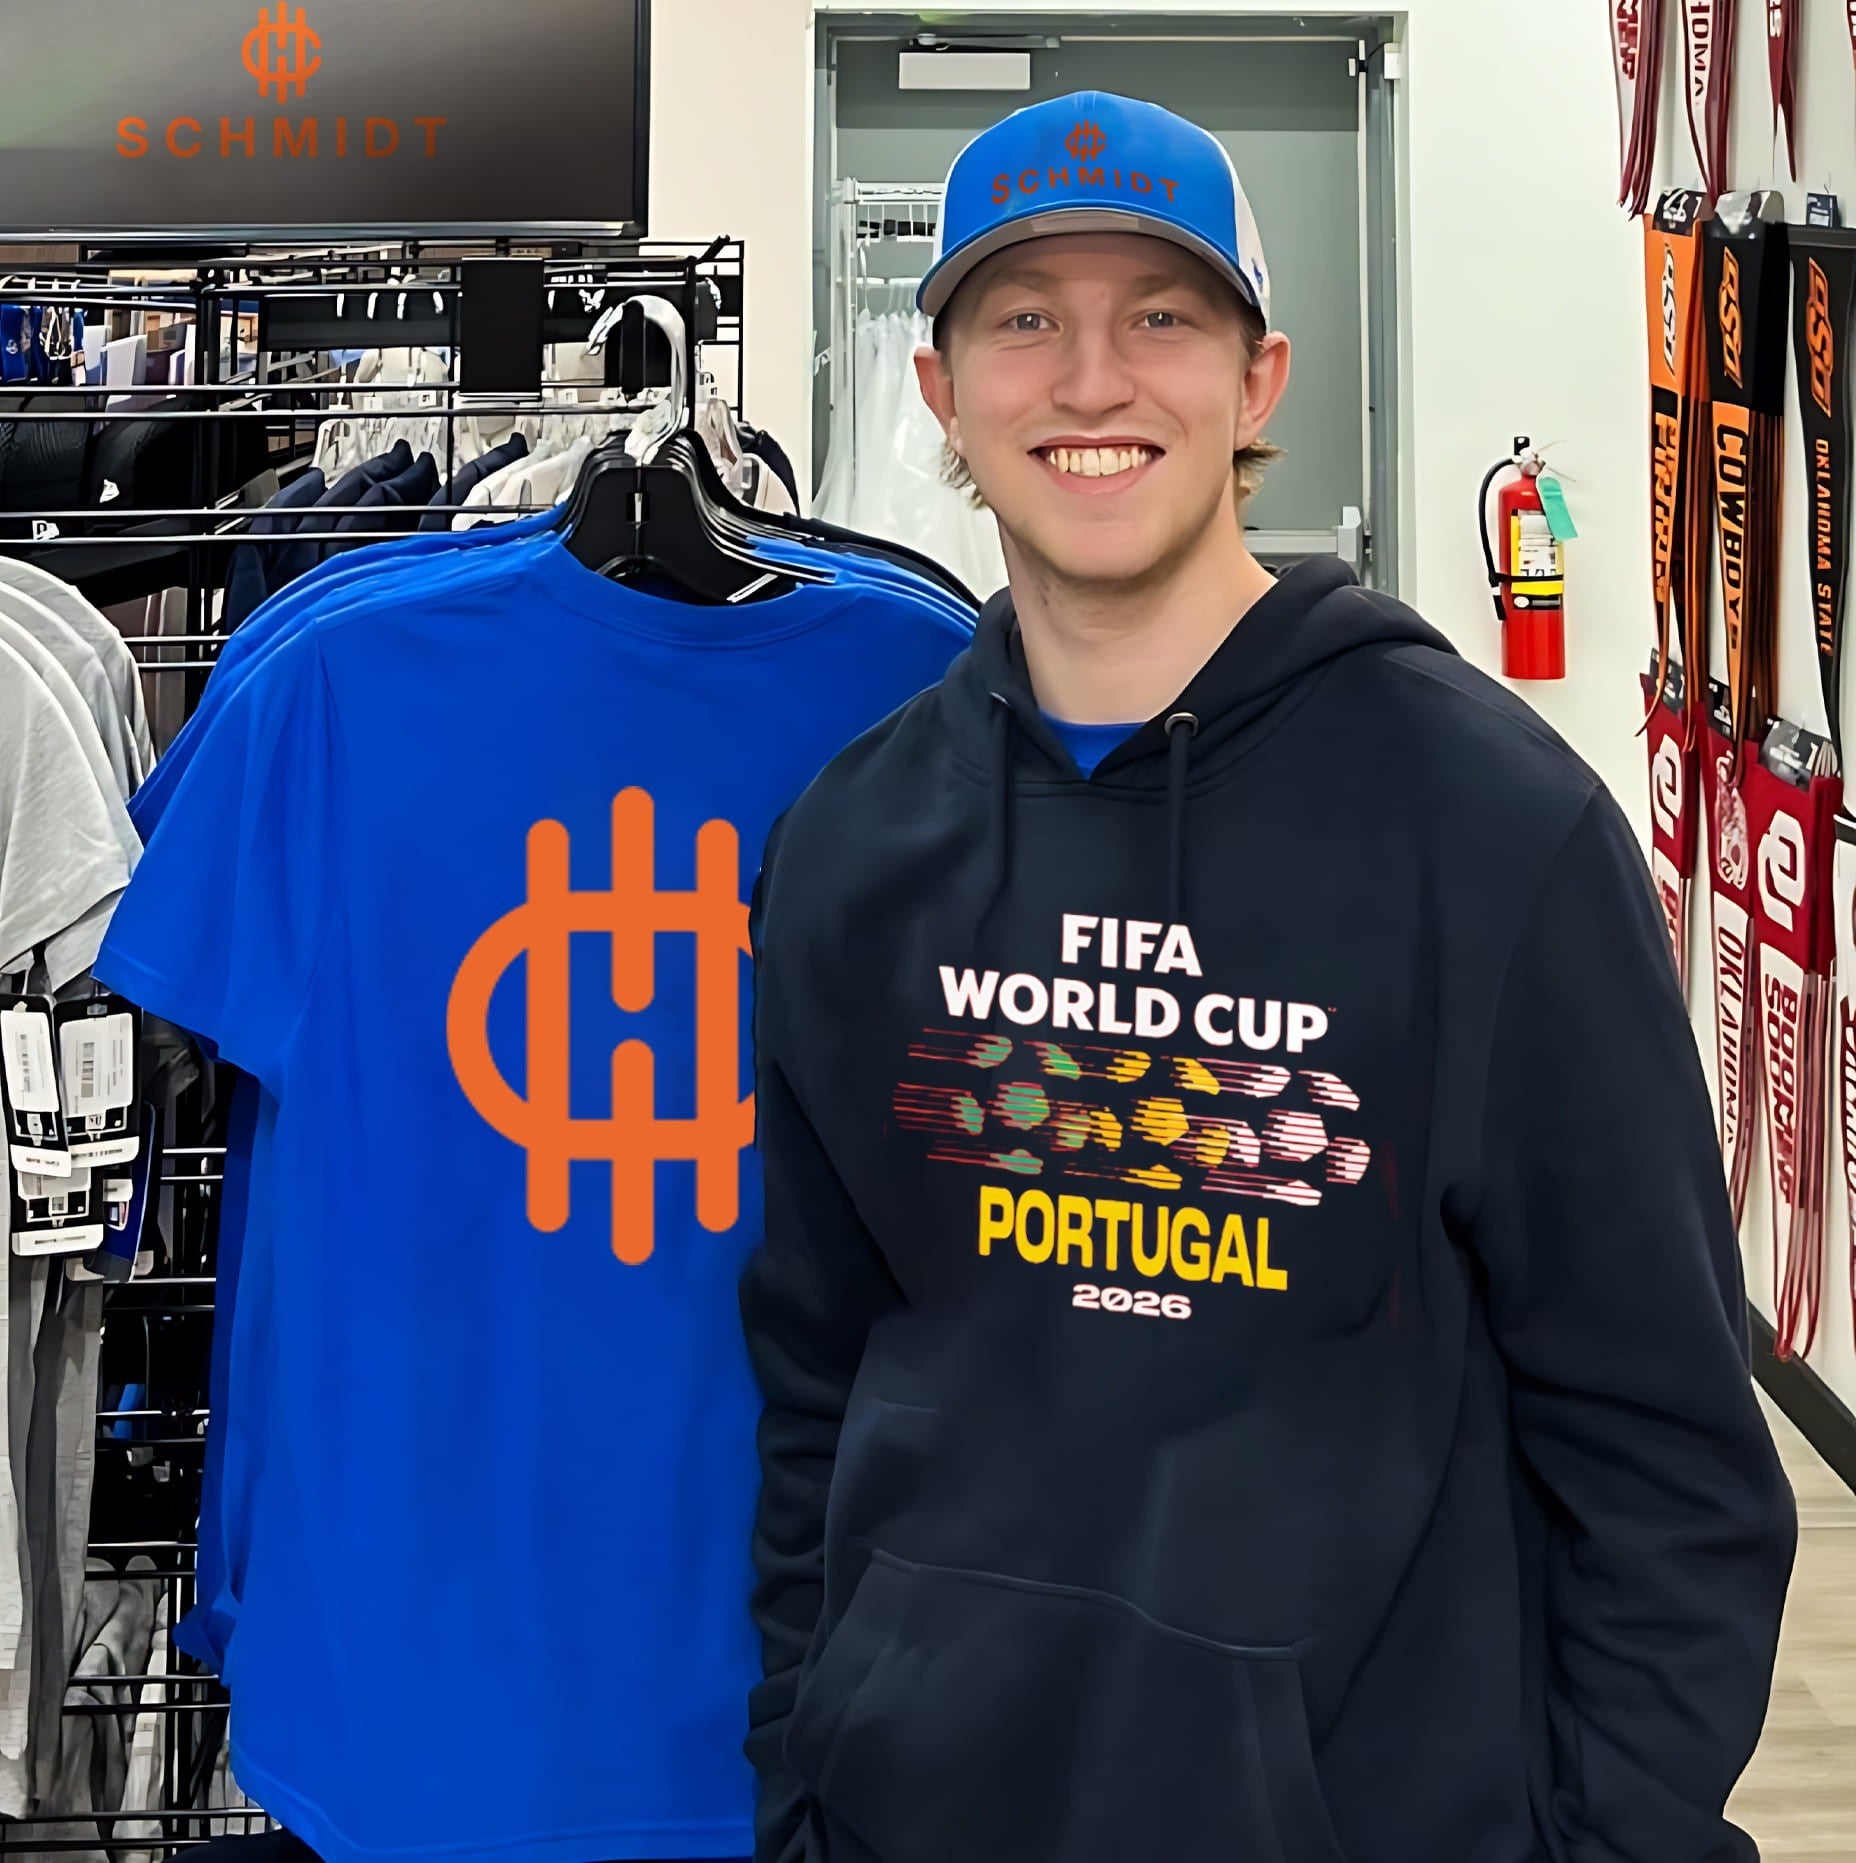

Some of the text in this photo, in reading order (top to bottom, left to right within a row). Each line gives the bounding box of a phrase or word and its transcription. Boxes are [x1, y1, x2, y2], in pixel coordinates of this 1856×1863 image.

[115, 116, 448, 159] SCHMIDT
[991, 167, 1180, 205] SCHMIDT
[1061, 913, 1203, 977] FIFA
[938, 965, 1329, 1053] WORLD CUP
[978, 1185, 1288, 1290] PORTUGAL
[1071, 1283, 1192, 1319] 2026
